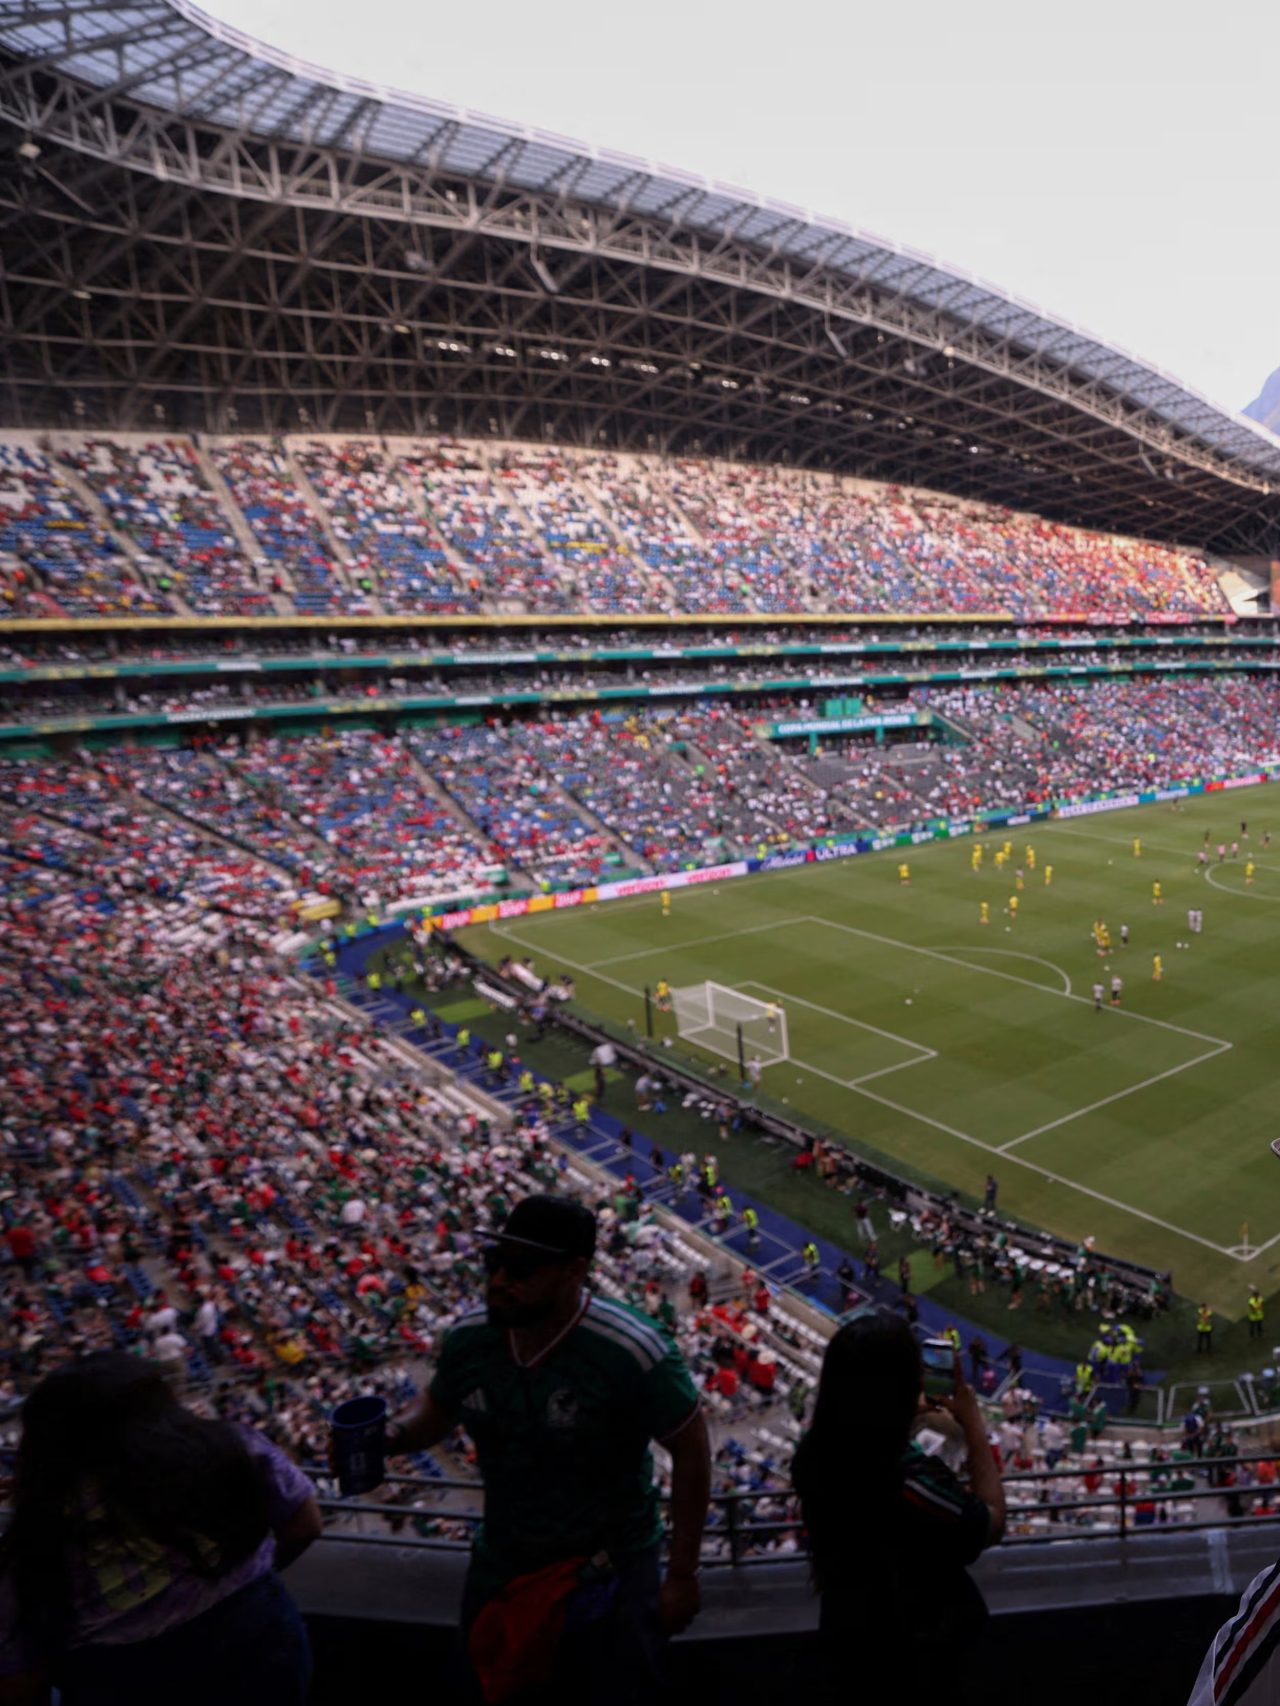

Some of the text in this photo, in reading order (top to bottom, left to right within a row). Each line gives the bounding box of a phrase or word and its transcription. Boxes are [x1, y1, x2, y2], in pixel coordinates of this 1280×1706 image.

[816, 844, 856, 861] ULTRA
[687, 868, 731, 883] verizon
[615, 880, 665, 896] verizon
